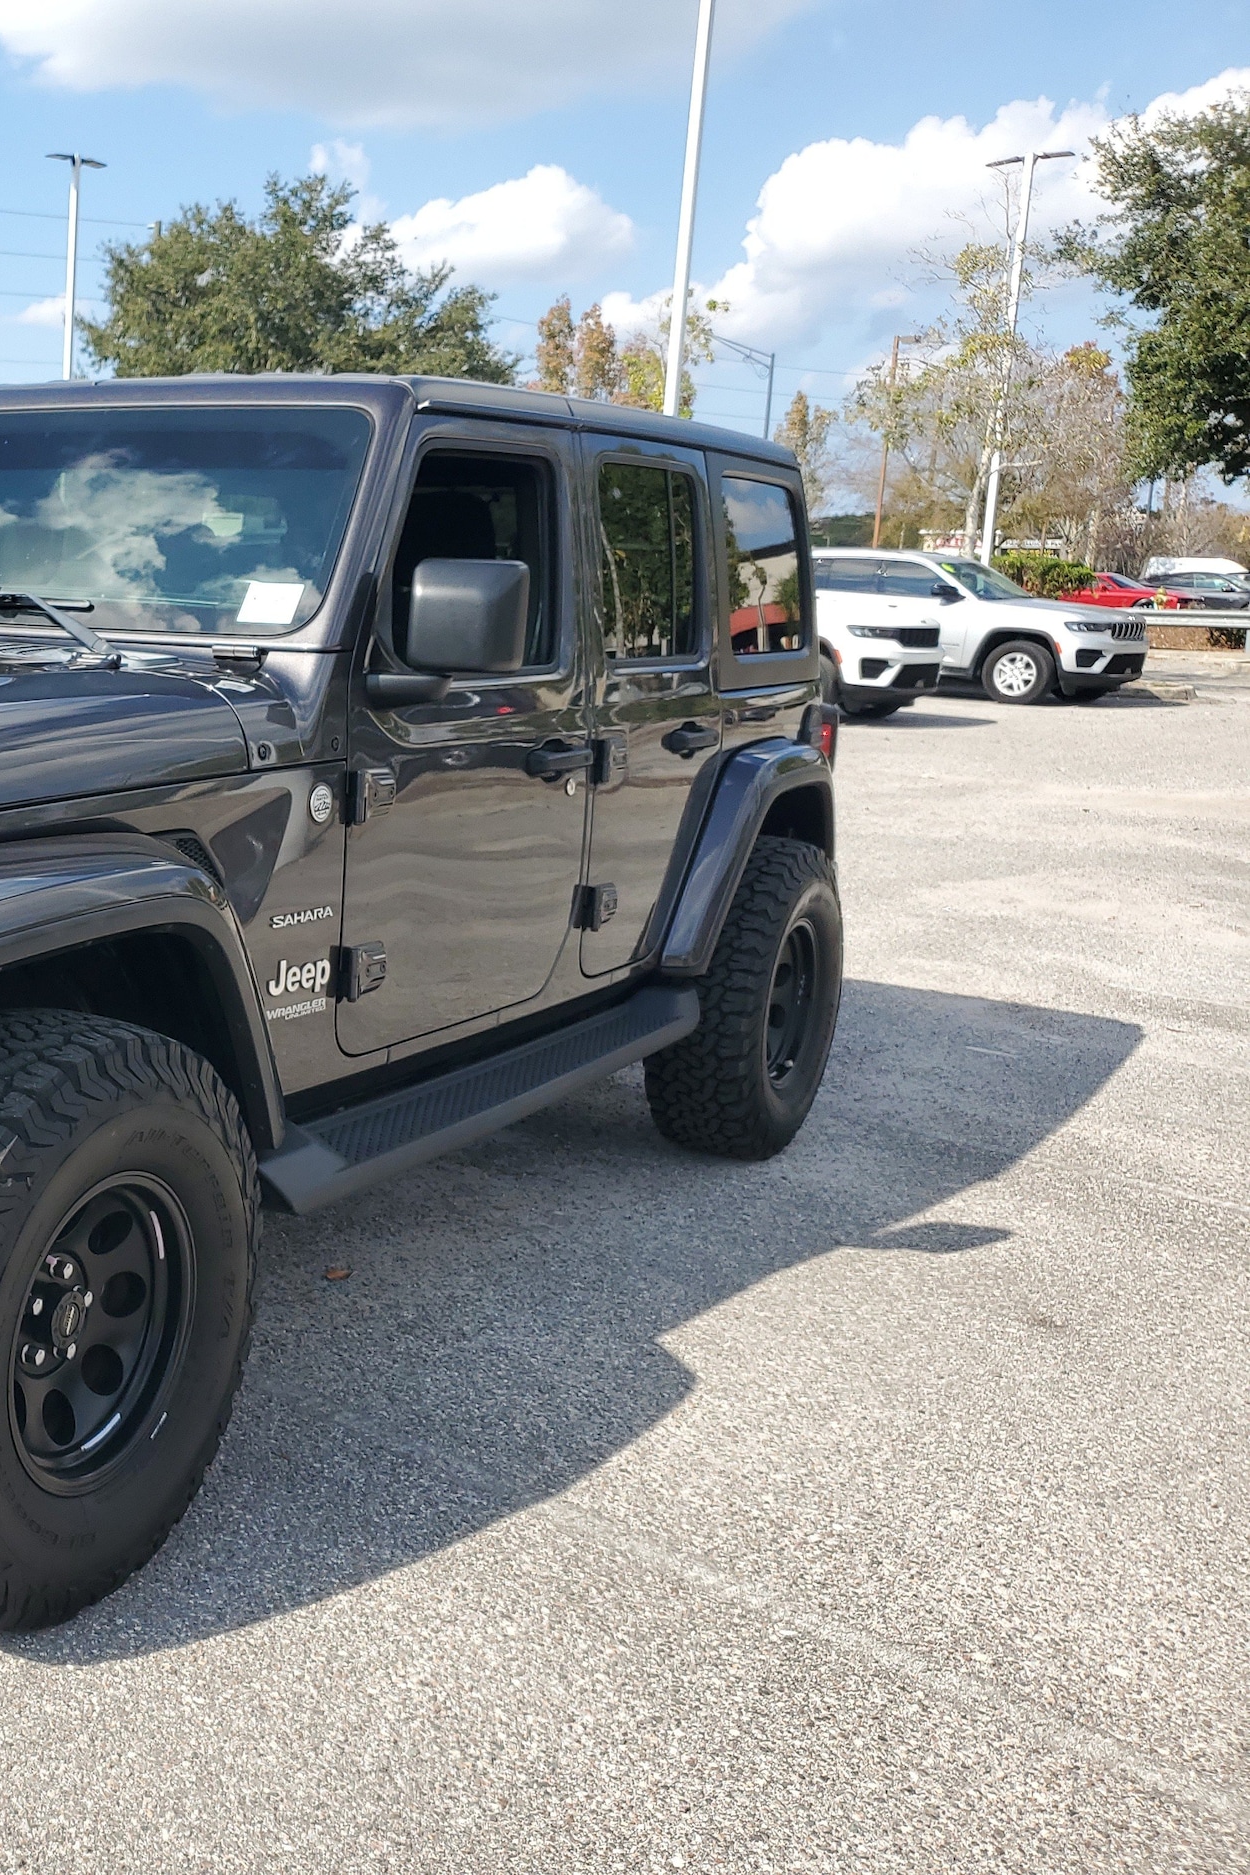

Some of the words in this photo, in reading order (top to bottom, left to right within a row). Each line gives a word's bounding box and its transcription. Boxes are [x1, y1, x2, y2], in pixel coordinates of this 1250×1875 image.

[270, 906, 334, 929] SAHARA
[267, 958, 331, 996] Jeep
[266, 998, 326, 1020] WRANGLER
